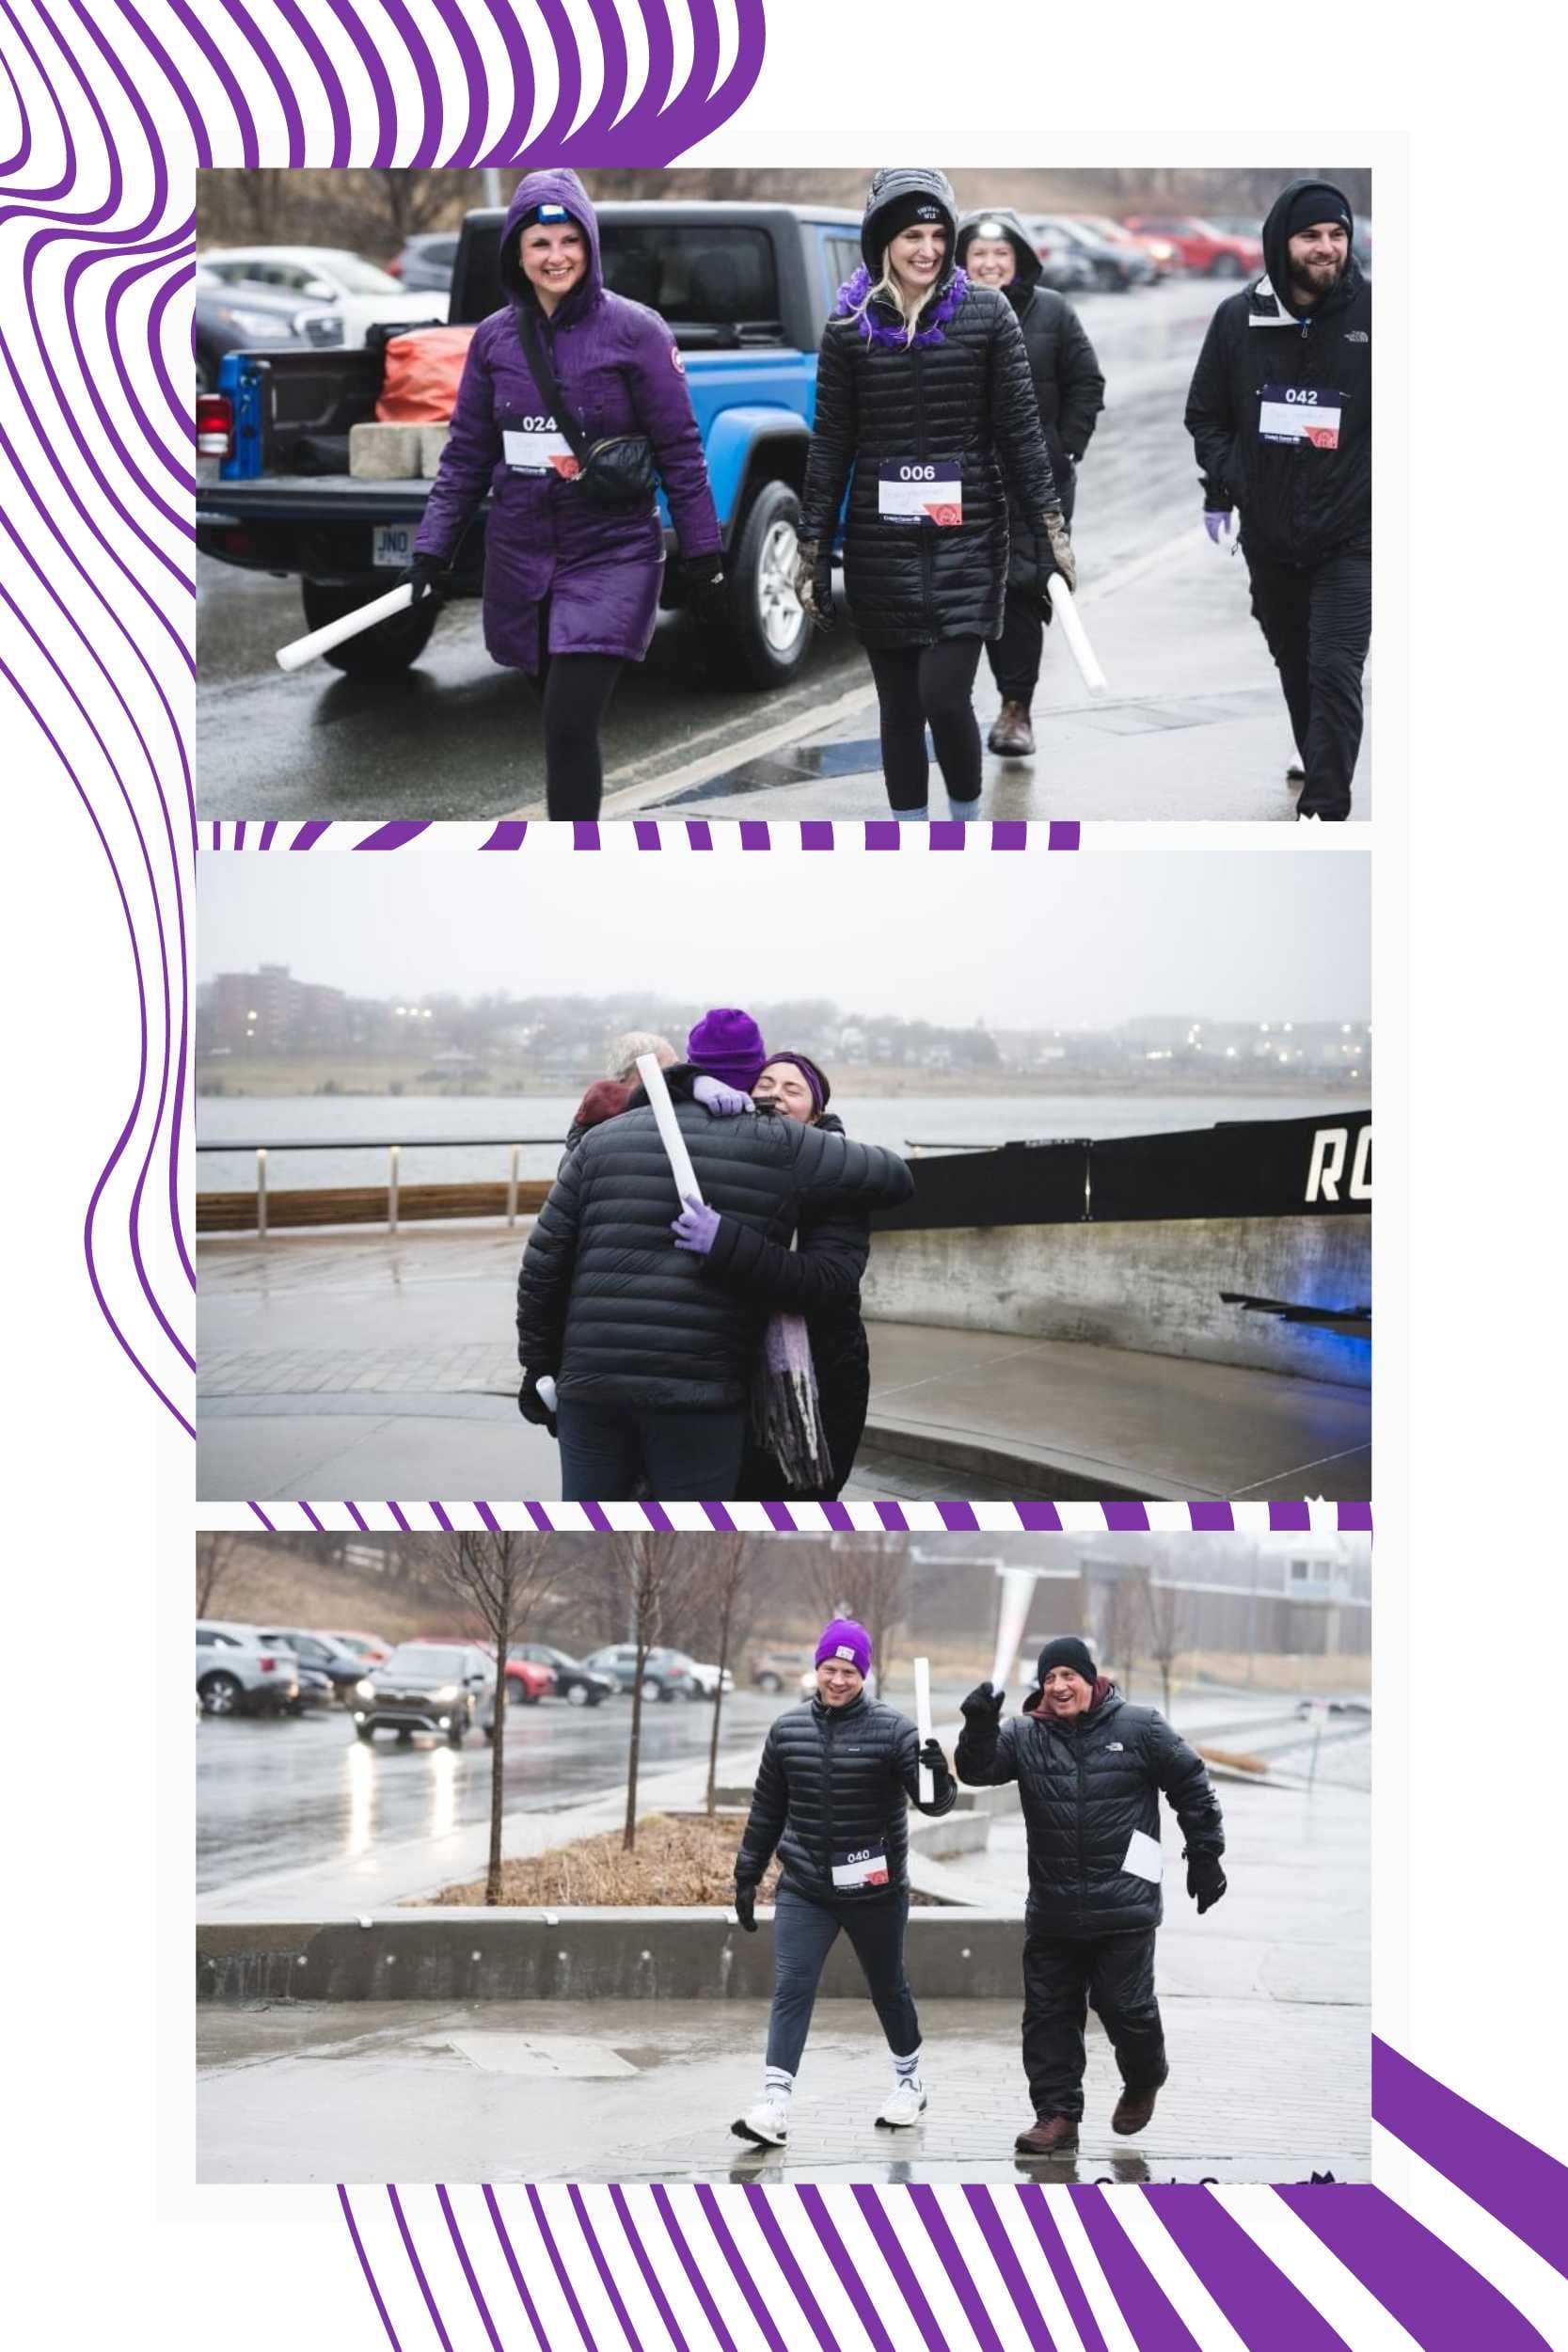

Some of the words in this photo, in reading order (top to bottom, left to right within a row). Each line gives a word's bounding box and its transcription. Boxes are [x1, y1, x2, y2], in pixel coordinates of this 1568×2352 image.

[1285, 389, 1318, 405] 042
[522, 416, 558, 432] 024
[900, 466, 936, 481] 006
[847, 1850, 870, 1864] 040
